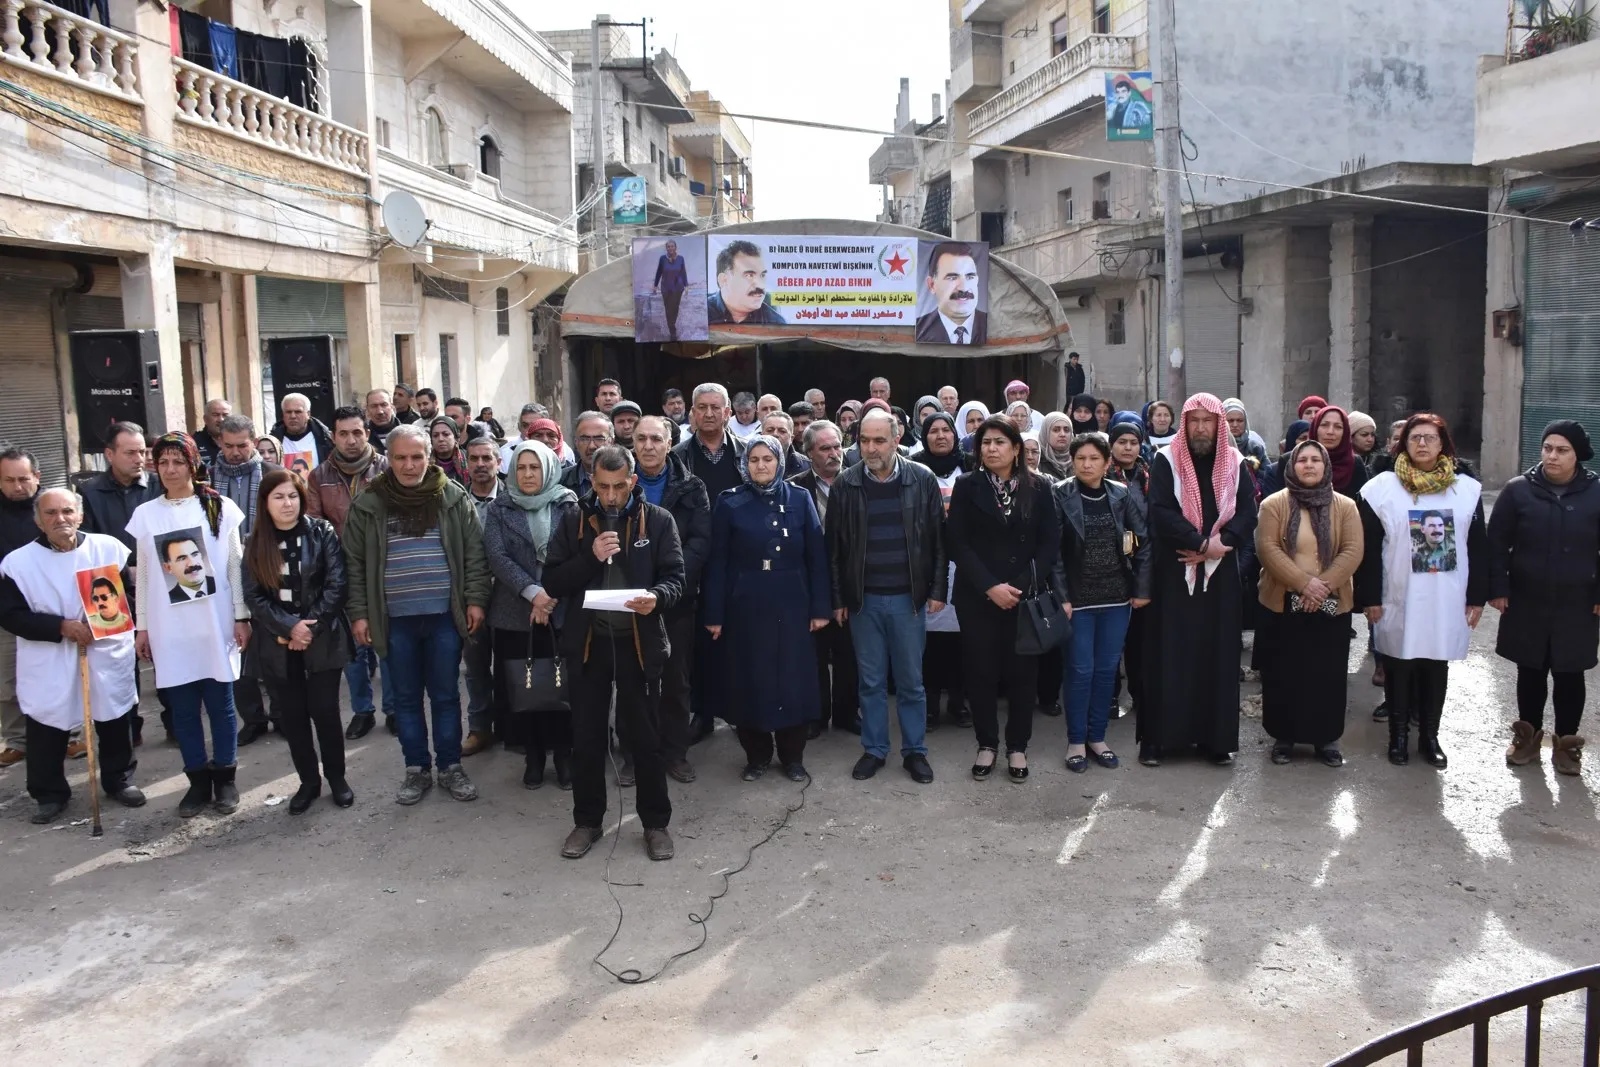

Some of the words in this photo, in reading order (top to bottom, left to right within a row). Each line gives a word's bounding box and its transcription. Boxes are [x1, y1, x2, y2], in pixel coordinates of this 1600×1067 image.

[805, 244, 822, 253] RUHÊ
[778, 276, 804, 286] RÊBER
[806, 278, 822, 286] APO
[824, 278, 846, 286] AZAD
[848, 278, 872, 286] BIKIN
[774, 294, 800, 303] الدولية
[802, 294, 828, 304] المؤامرة
[858, 294, 886, 304] والمقاومة
[796, 307, 819, 319] أوجلان
[821, 308, 832, 318] الله
[835, 310, 848, 319] عبد
[851, 309, 870, 318] القائد
